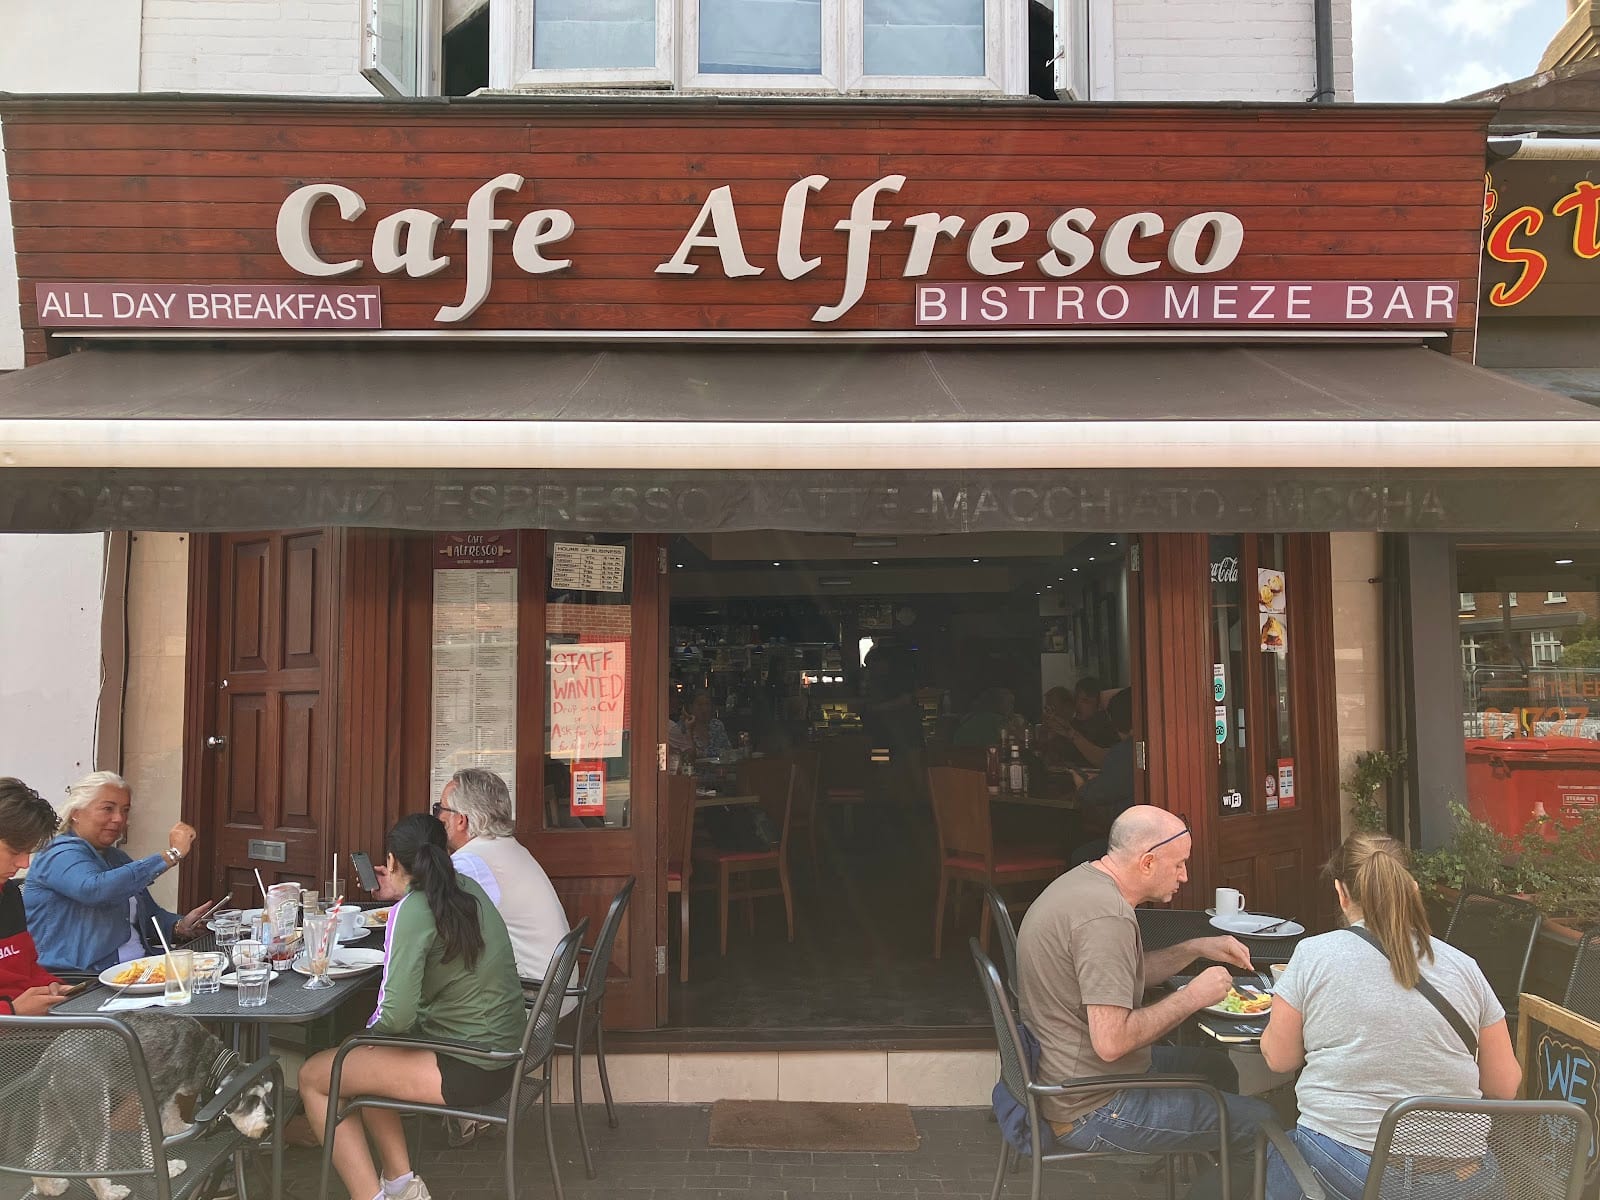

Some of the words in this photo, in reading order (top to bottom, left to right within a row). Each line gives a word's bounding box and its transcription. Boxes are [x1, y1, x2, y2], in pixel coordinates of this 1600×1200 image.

[275, 173, 575, 324] Cafe
[653, 175, 1245, 324] Alfresco
[42, 291, 103, 318] ALL
[112, 292, 177, 319] DAY
[187, 293, 377, 320] BREAKFAST
[919, 285, 1130, 321] BISTRO
[1163, 285, 1312, 320] MEZE
[1346, 285, 1455, 320] BAR
[434, 484, 710, 522] ESPRESSO
[453, 544, 497, 557] ALFRESCO
[554, 651, 613, 674] STAFF
[553, 674, 624, 699] WANTED
[598, 701, 617, 712] CV
[1483, 706, 1590, 740] 01727
[1545, 1043, 1590, 1105] WE
